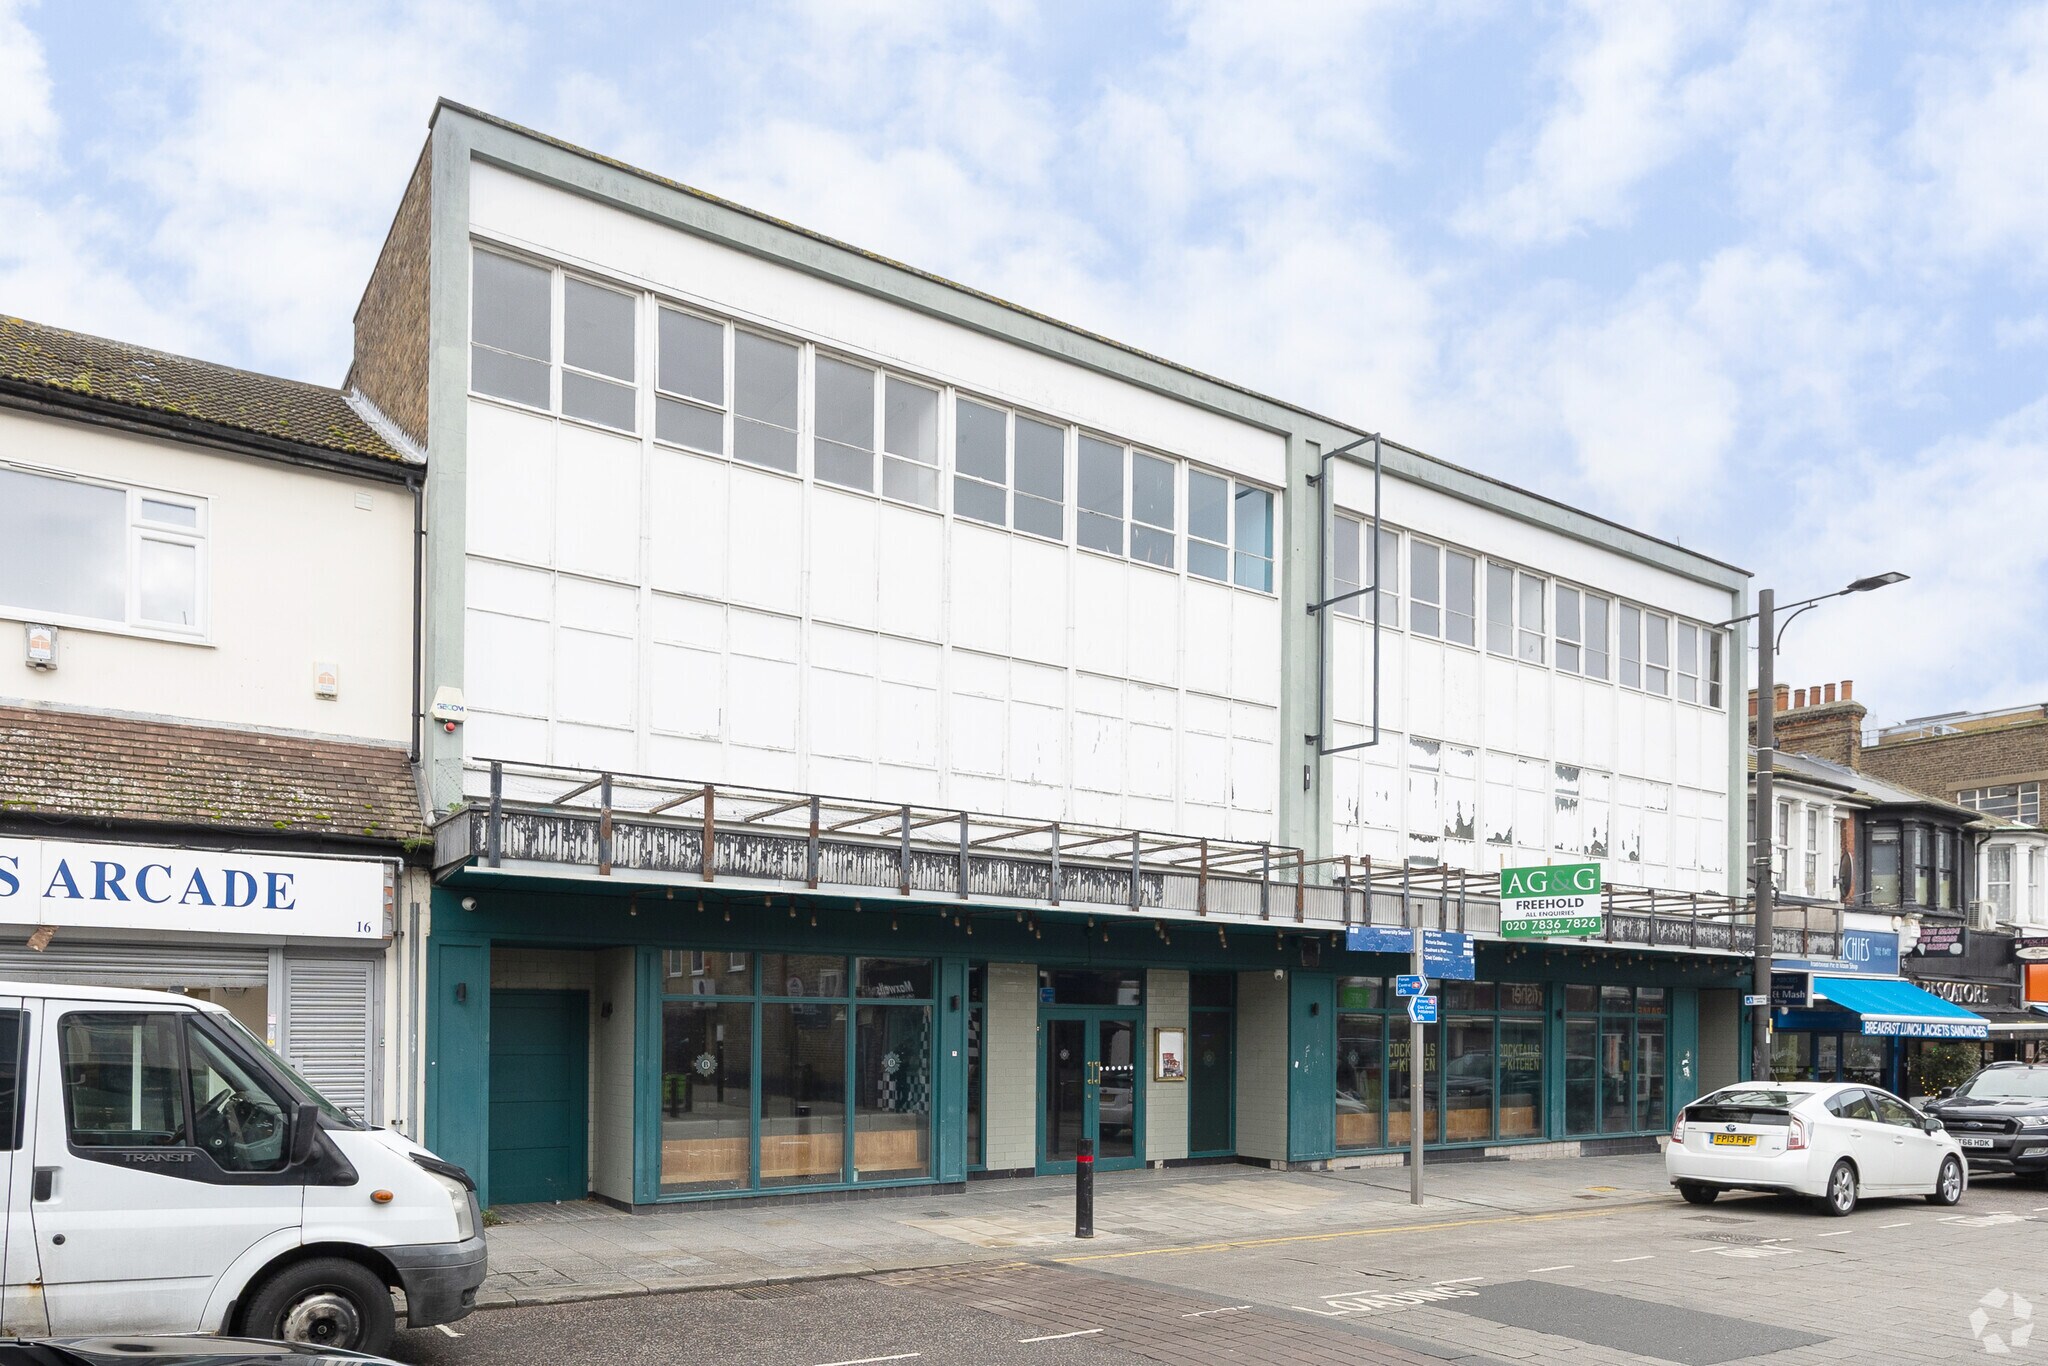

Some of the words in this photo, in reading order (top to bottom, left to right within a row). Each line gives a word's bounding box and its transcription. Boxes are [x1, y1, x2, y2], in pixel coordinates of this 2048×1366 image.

[42, 858, 296, 910] ARCADE
[1506, 868, 1595, 894] AG&G
[1516, 898, 1584, 910] FREEHOLD
[356, 921, 371, 934] 16
[1506, 921, 1527, 930] 020
[1532, 919, 1561, 929] 7836
[1567, 918, 1596, 928] 7826
[1839, 936, 1870, 962] ICHIES
[1782, 990, 1805, 998] Mash
[1865, 1021, 1900, 1034] BREAKFAST
[1900, 1023, 1921, 1035] LUNCH
[1922, 1024, 1950, 1036] JACKETS
[1950, 1025, 1987, 1037] SANDWICHES
[1389, 1043, 1436, 1057] COCKLS
[1507, 1056, 1539, 1071] KITCHEN
[1716, 1134, 1735, 1143] FP13
[1736, 1135, 1754, 1144] FWF
[1974, 1139, 1990, 1147] HDK
[122, 1153, 195, 1162] TRANSIT
